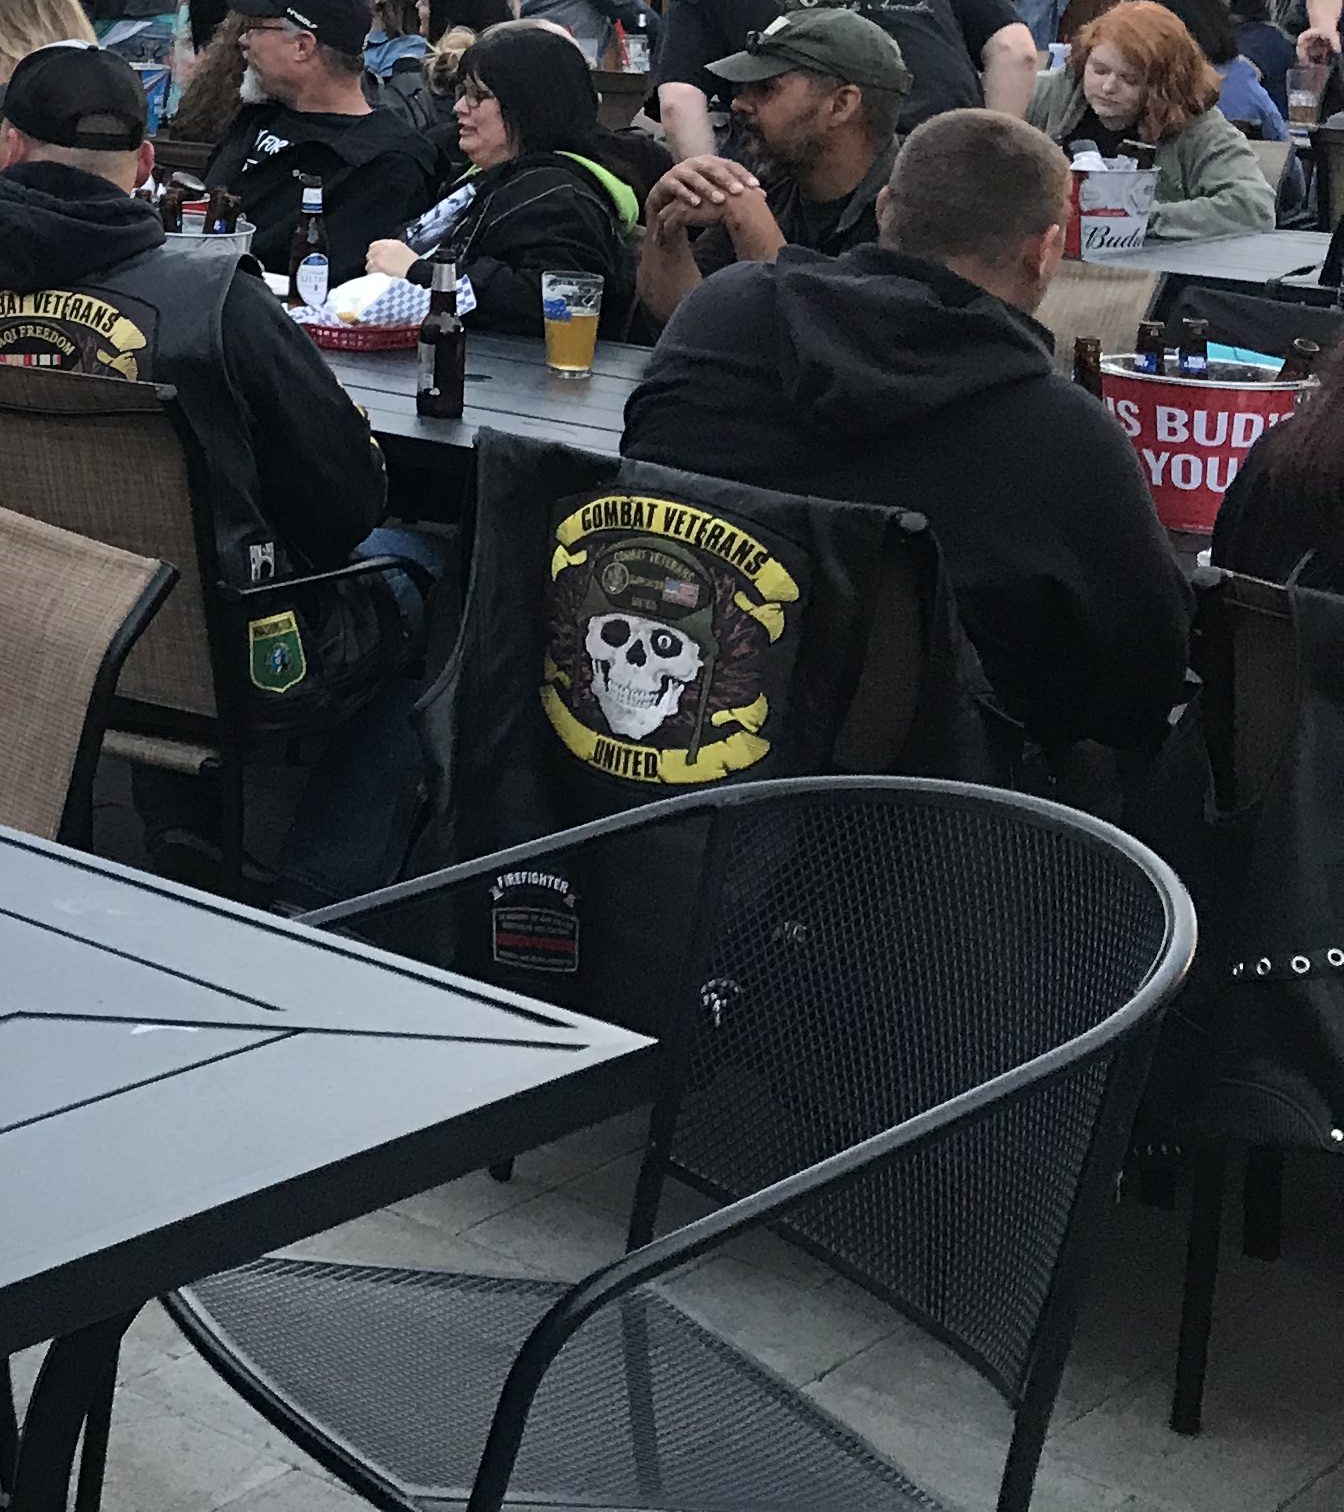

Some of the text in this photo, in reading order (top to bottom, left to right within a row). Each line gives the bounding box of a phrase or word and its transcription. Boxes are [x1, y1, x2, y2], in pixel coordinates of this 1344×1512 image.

[32, 293, 119, 333] VETERANS
[19, 325, 76, 356] FREEDOM
[581, 500, 764, 576] COMBAT VETERANS
[593, 738, 659, 779] UNITED
[496, 871, 569, 894] FIREFIGHTER
